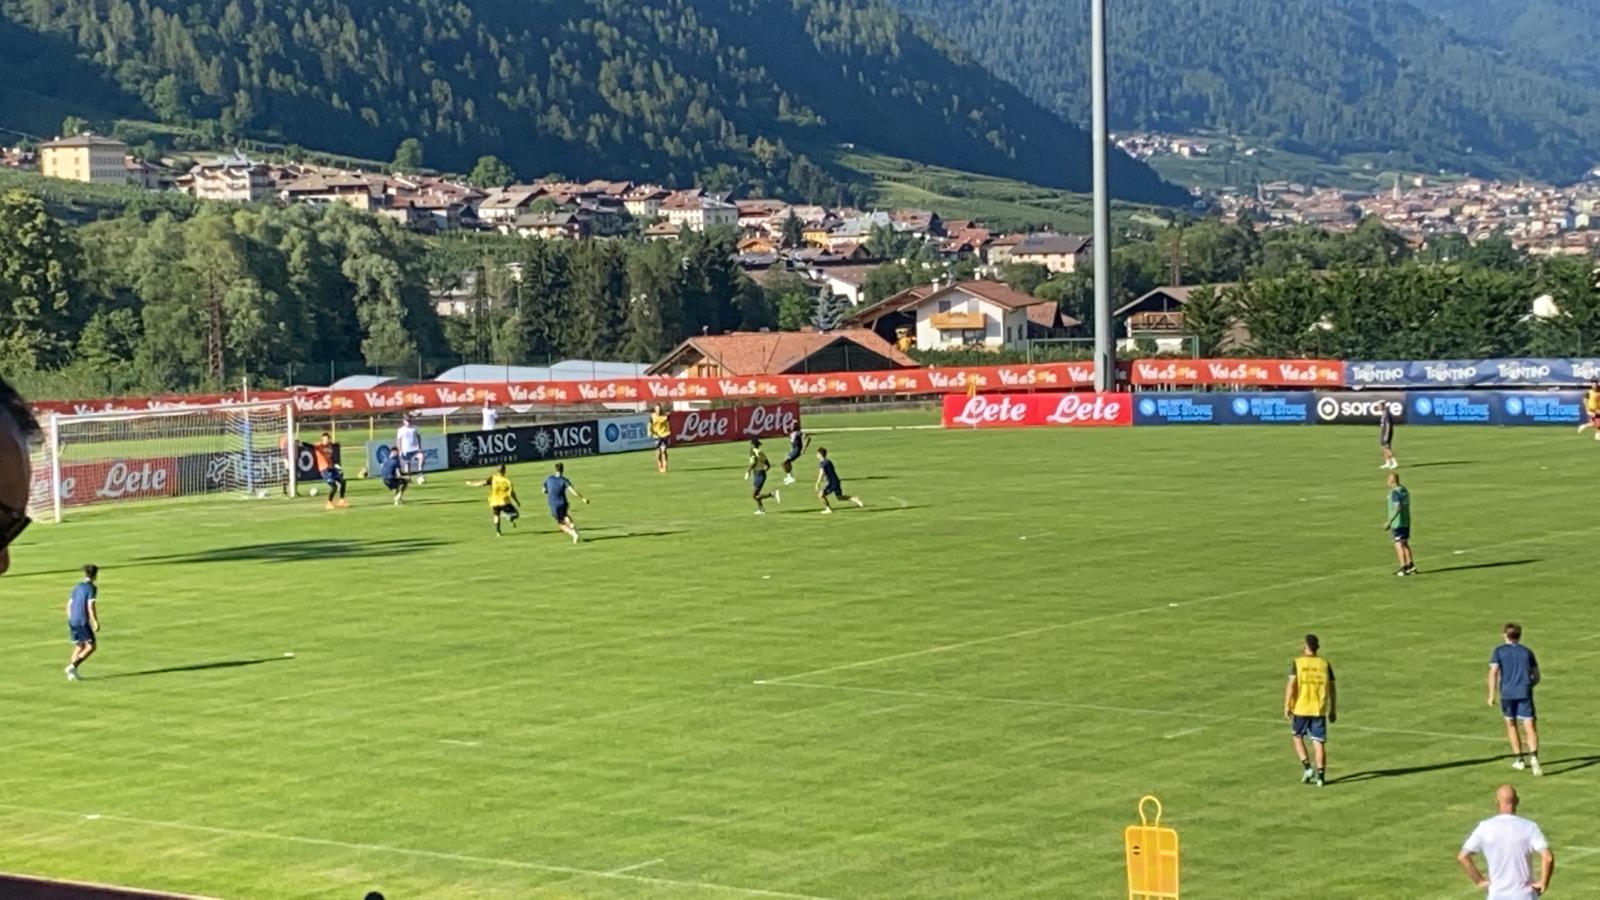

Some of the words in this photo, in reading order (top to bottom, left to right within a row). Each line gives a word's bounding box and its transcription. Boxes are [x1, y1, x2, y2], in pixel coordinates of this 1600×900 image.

[743, 406, 793, 434] Lete
[953, 395, 1027, 424] Lete
[1046, 394, 1120, 423] Lete
[553, 425, 592, 447] MSC
[676, 412, 728, 441] Lete
[477, 432, 517, 455] MSC
[96, 463, 166, 497] Lete
